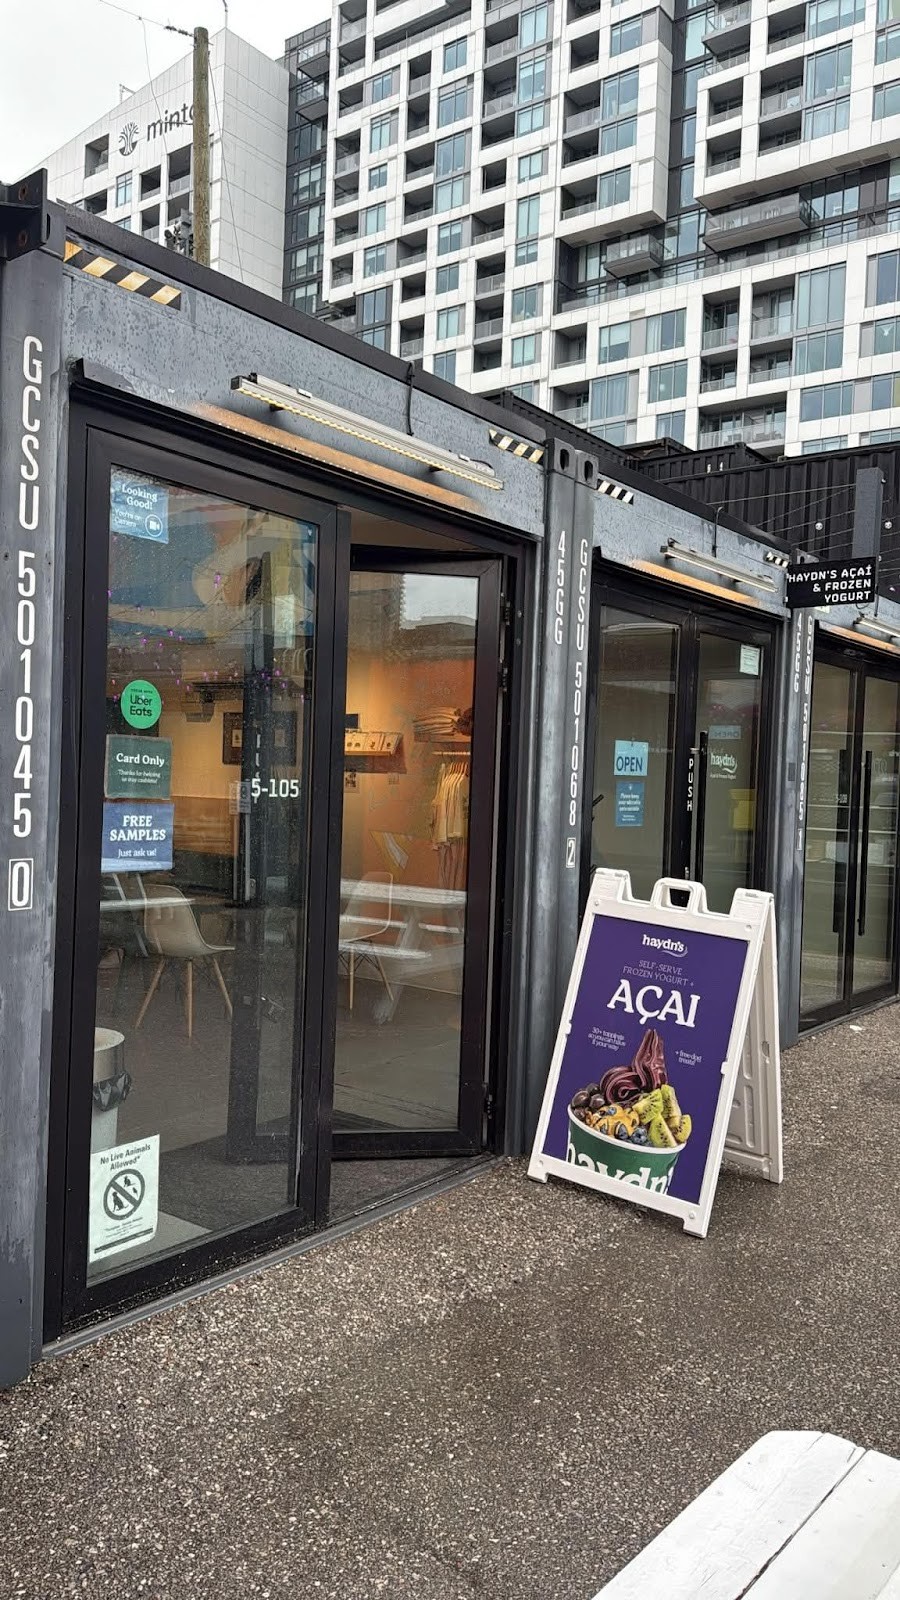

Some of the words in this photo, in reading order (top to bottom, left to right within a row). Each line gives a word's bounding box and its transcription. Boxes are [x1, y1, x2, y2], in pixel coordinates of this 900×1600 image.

[19, 335, 43, 530] GCSU
[122, 483, 158, 502] Looking
[126, 496, 153, 510] Good!
[788, 570, 837, 583] HAYDN'S
[813, 583, 821, 592] &
[825, 579, 871, 591] FROZEN
[576, 539, 588, 651] GCSU
[824, 591, 871, 603] YOGURT
[13, 550, 36, 838] 501045
[130, 693, 152, 706] Uber
[129, 705, 152, 717] Eats
[569, 662, 583, 826] 501068
[116, 752, 140, 764] Card
[142, 754, 165, 767] Only
[616, 756, 643, 772] OPEN
[251, 778, 299, 798] 5-105
[122, 815, 153, 827] FREE
[109, 828, 167, 841] SAMPLES
[118, 848, 132, 859] Just
[133, 847, 146, 857] ask
[146, 848, 157, 857] us!
[642, 934, 685, 953] haydn's
[622, 965, 654, 979] FROZEN
[654, 971, 688, 986] YOGURT
[607, 979, 701, 1027] AÇAI
[100, 1156, 109, 1165] No
[110, 1152, 124, 1162] Live
[125, 1143, 151, 1157] Animals
